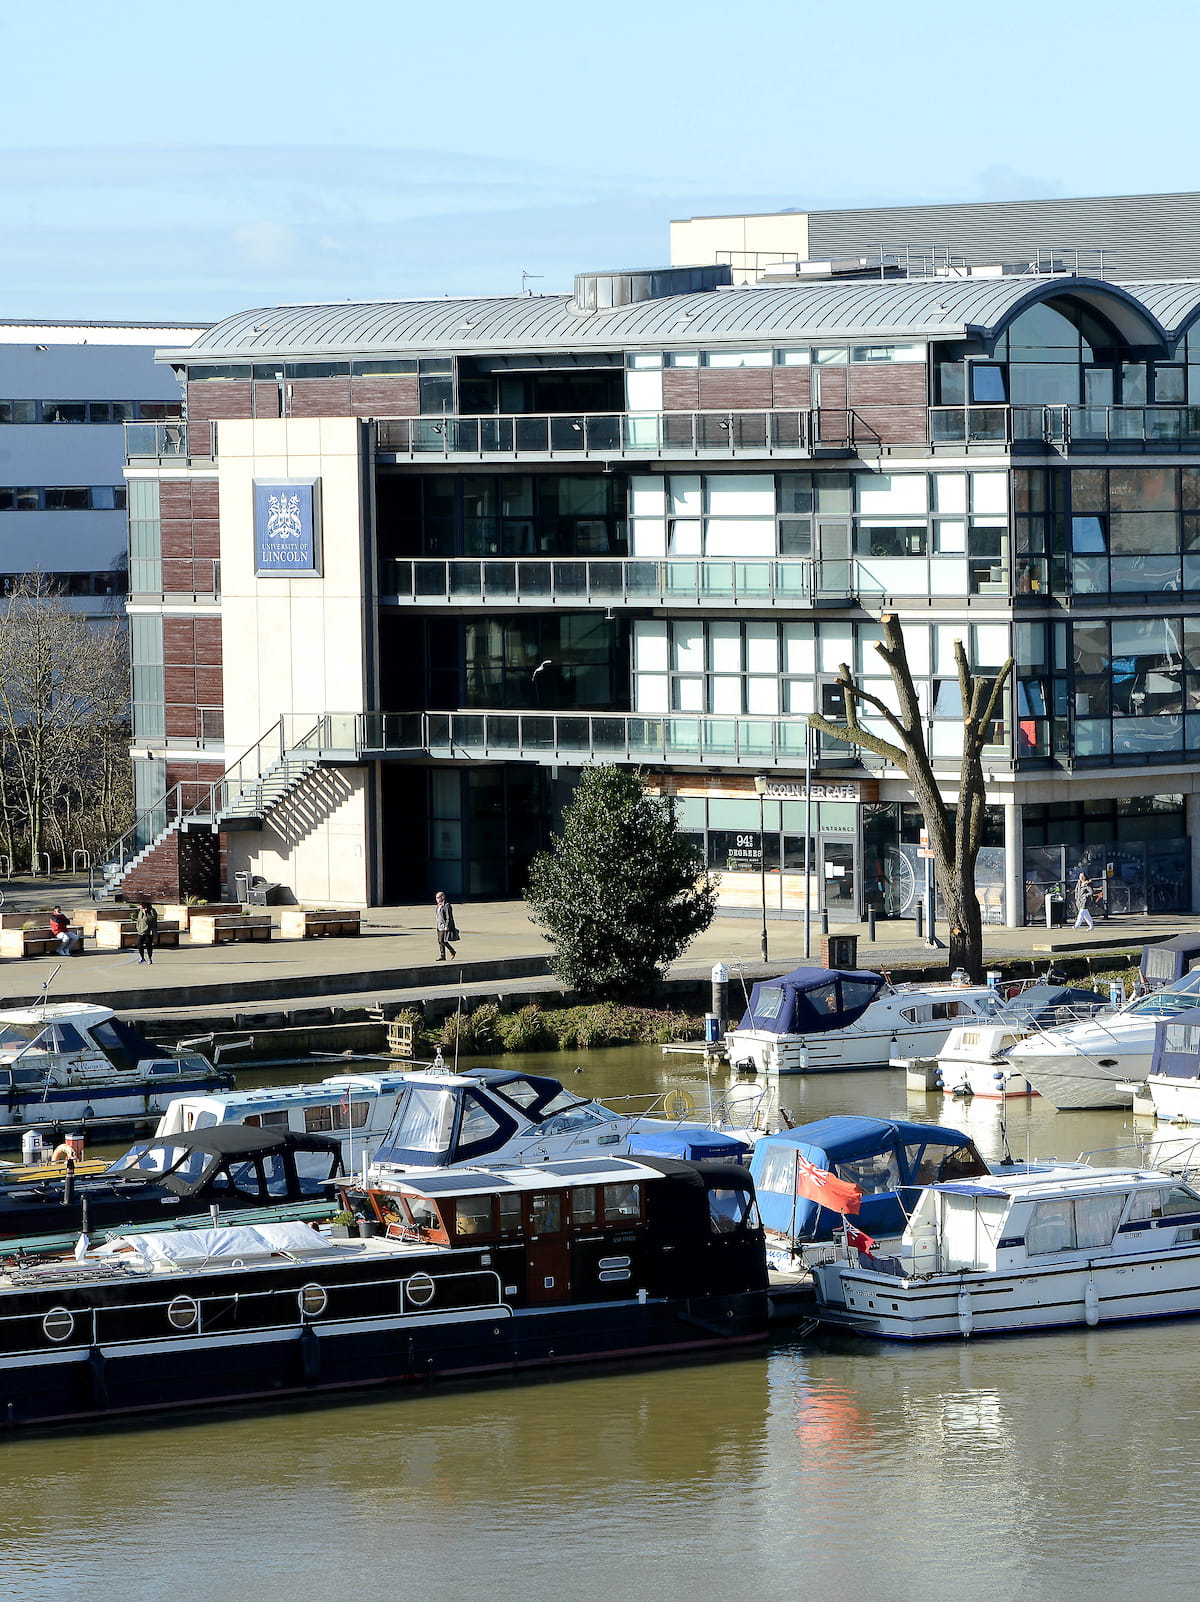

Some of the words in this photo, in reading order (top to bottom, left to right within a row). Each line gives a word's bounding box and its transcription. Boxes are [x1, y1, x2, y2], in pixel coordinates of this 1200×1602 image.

[262, 551, 308, 561] LINCOLN
[765, 783, 799, 797] NCOLN
[801, 785, 824, 798] PER
[825, 783, 855, 799] CAFÉ
[728, 848, 762, 858] DEGREES
[33, 1138, 41, 1148] B
